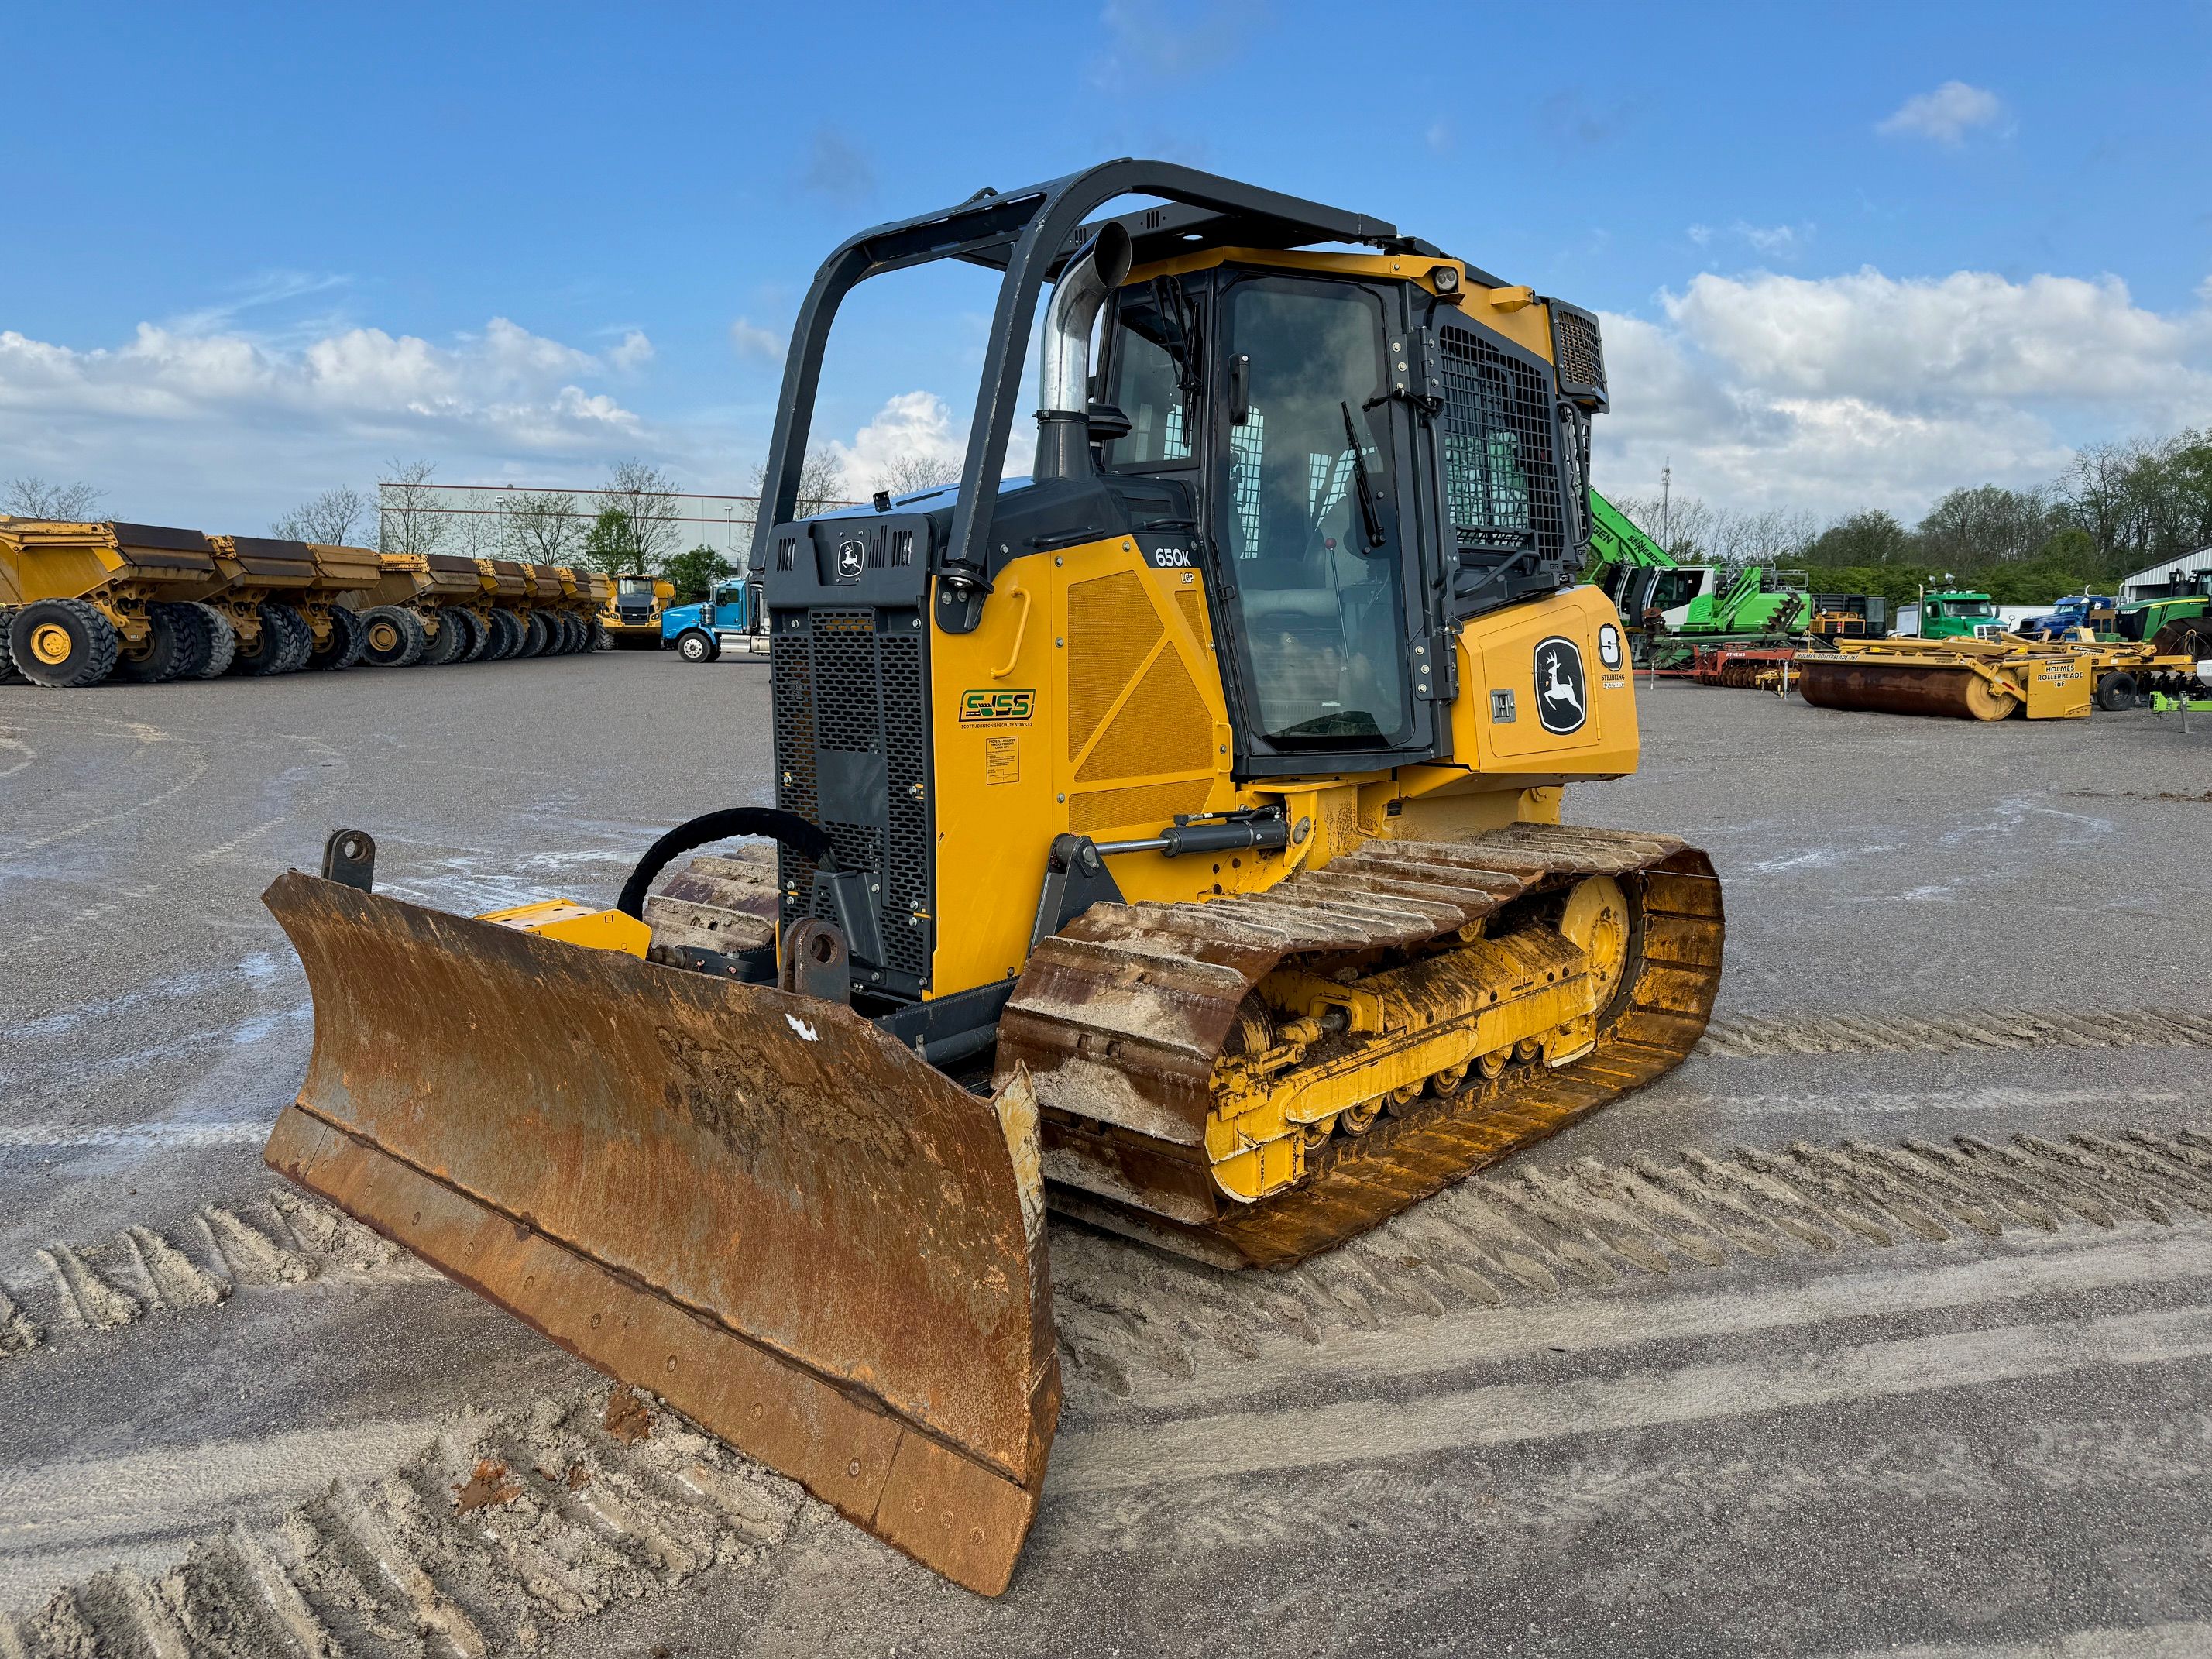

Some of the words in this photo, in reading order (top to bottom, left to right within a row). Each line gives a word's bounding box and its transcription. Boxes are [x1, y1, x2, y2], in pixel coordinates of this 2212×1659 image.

[1593, 521, 1615, 544] GEN
[1156, 548, 1192, 567] 650K
[1627, 535, 1667, 566] SENNEBOG
[1180, 572, 1194, 584] LGP
[2037, 672, 2083, 681] ROLLERBLADE
